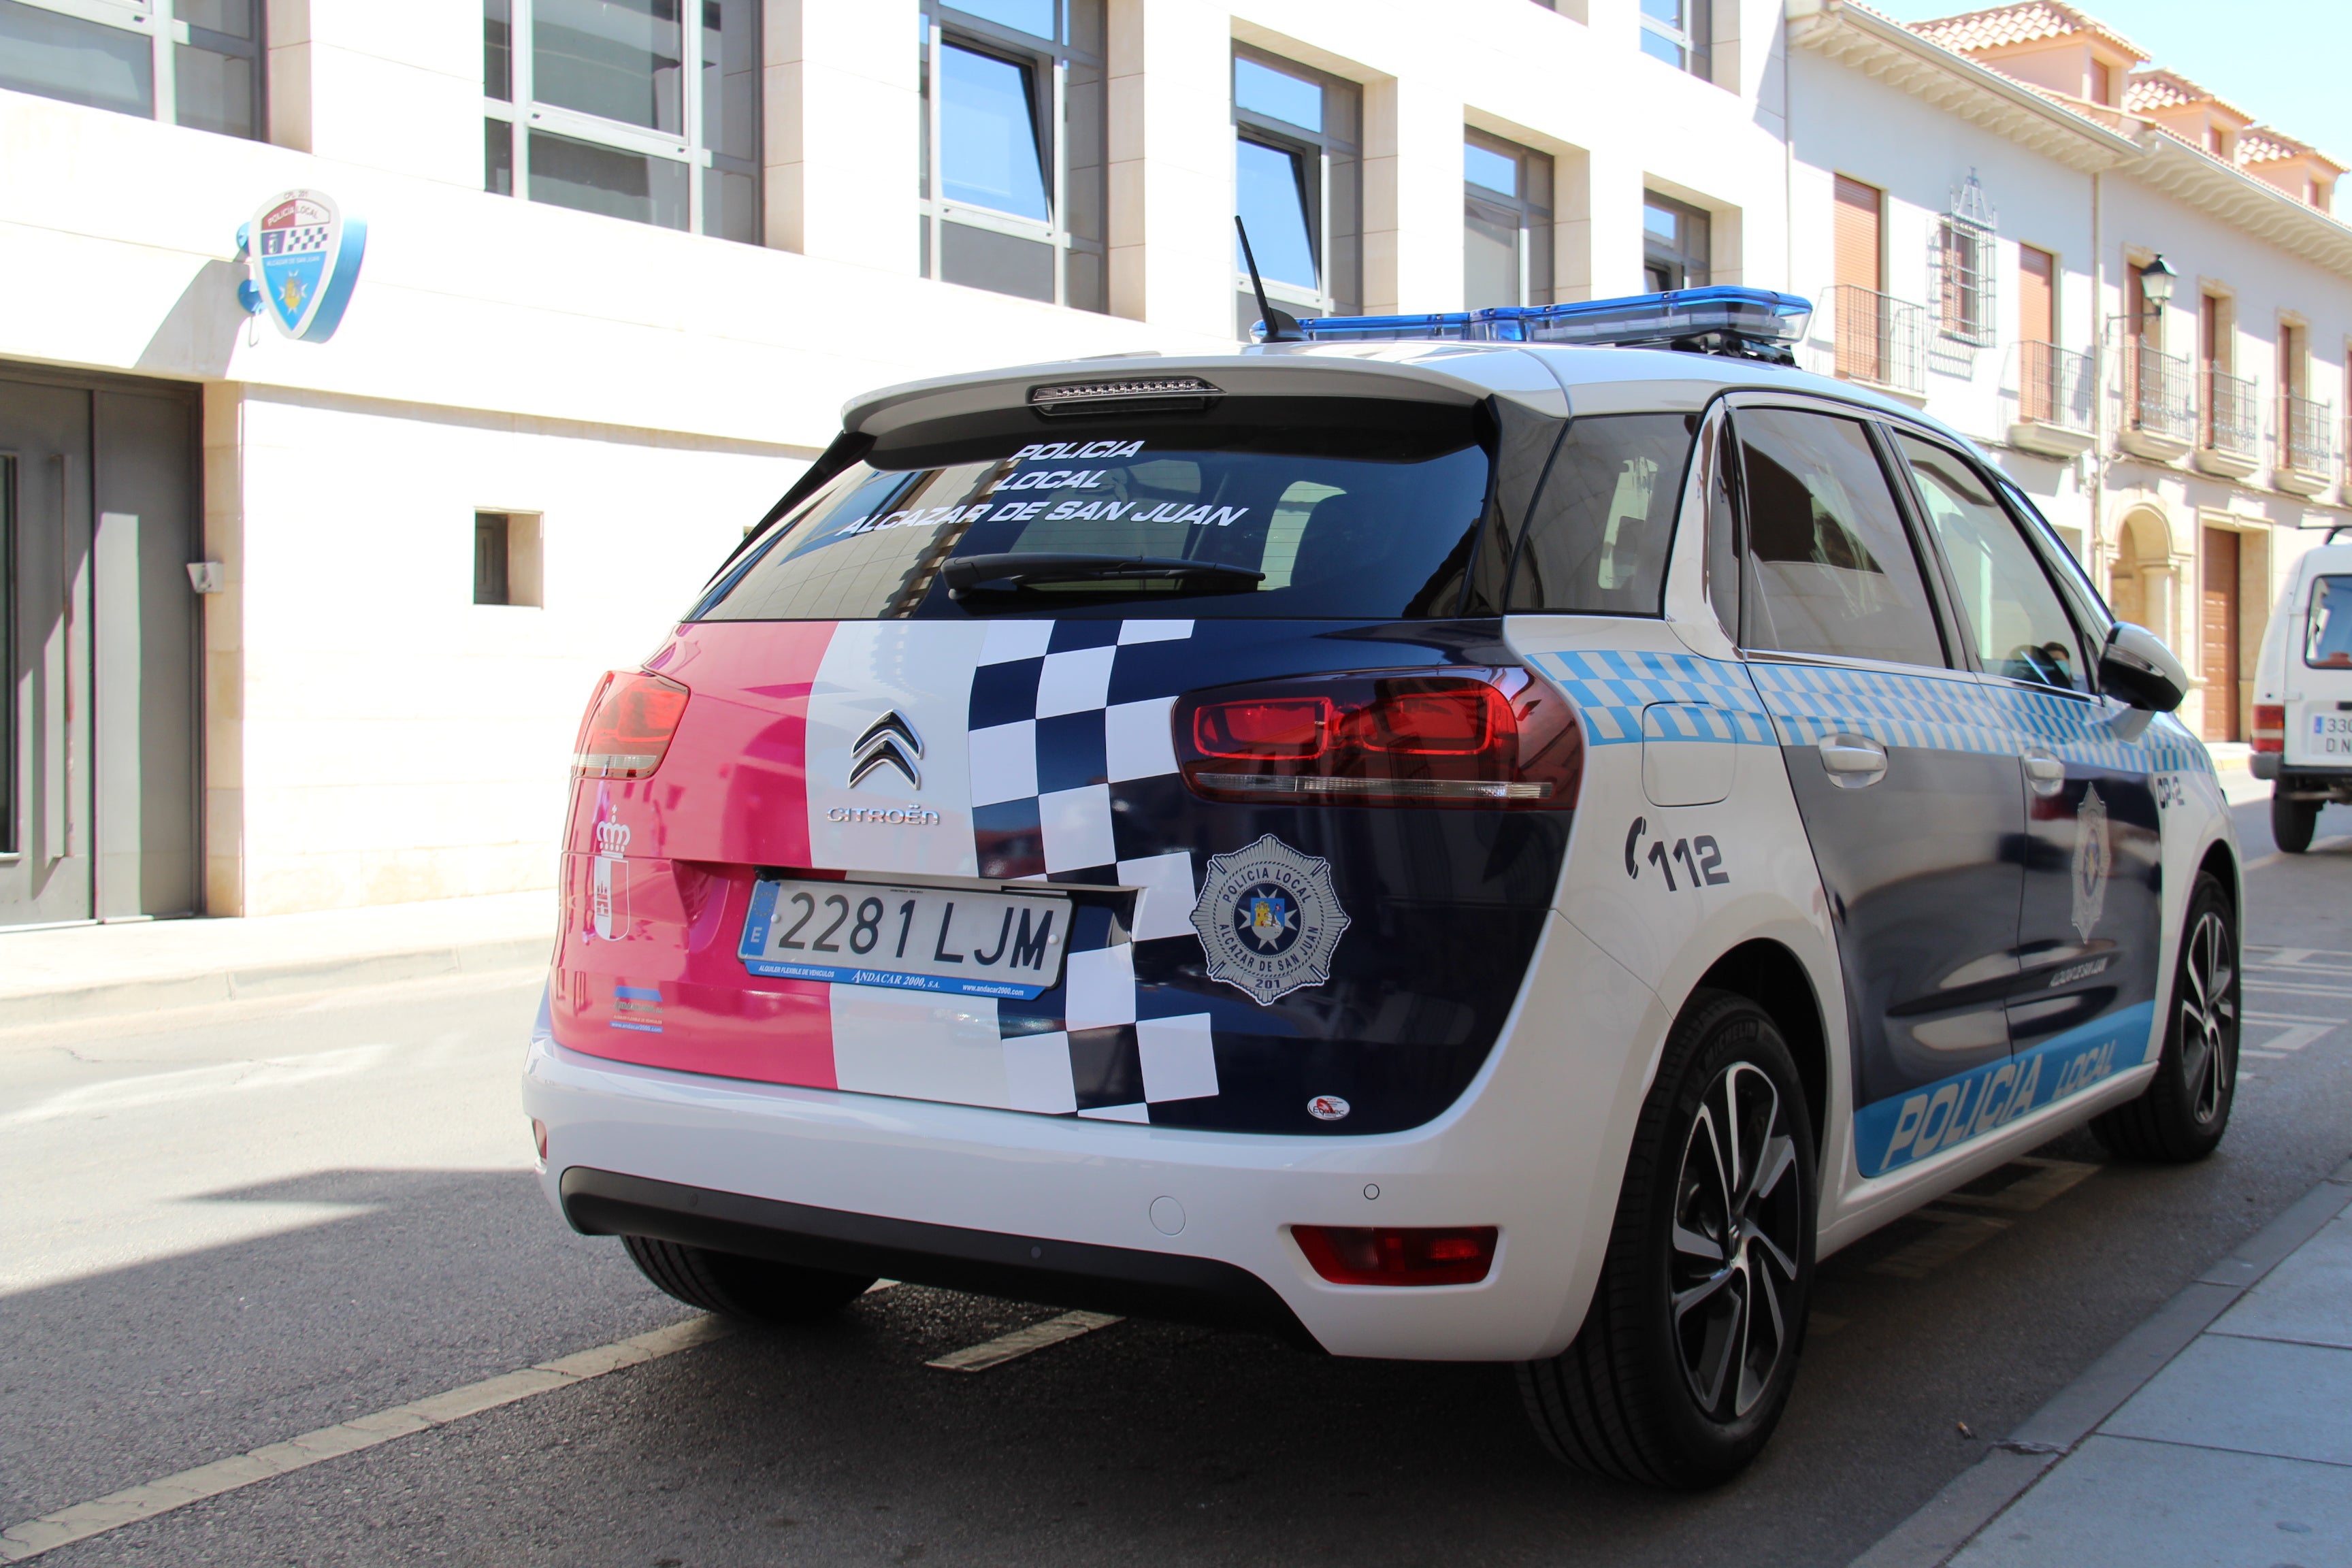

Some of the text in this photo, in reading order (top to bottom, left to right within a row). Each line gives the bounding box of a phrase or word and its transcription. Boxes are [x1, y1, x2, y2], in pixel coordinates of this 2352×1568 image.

[295, 206, 318, 218] LOCAL
[1009, 440, 1145, 461] POLICIA
[993, 470, 1107, 491] LOCAL
[836, 501, 1248, 536] ALCAZAR DE SAN JUAN
[827, 804, 939, 825] CITROËN
[1648, 835, 1730, 892] 112
[1222, 867, 1312, 904] POLICIA LOCAL
[751, 926, 762, 943] E
[779, 892, 1054, 970] 2281 LJM
[1220, 923, 1319, 973] ALCAZAR DE SAN JUAN
[781, 966, 802, 975] FLEXIBLE
[851, 969, 940, 989] ANDACAR 2000, S.A.
[962, 983, 1024, 996] www.andacar2000.com
[1254, 979, 1281, 989] 201
[1703, 1021, 1758, 1071] MICHELIN
[1880, 1041, 2116, 1171] POLICIA LOCAL
